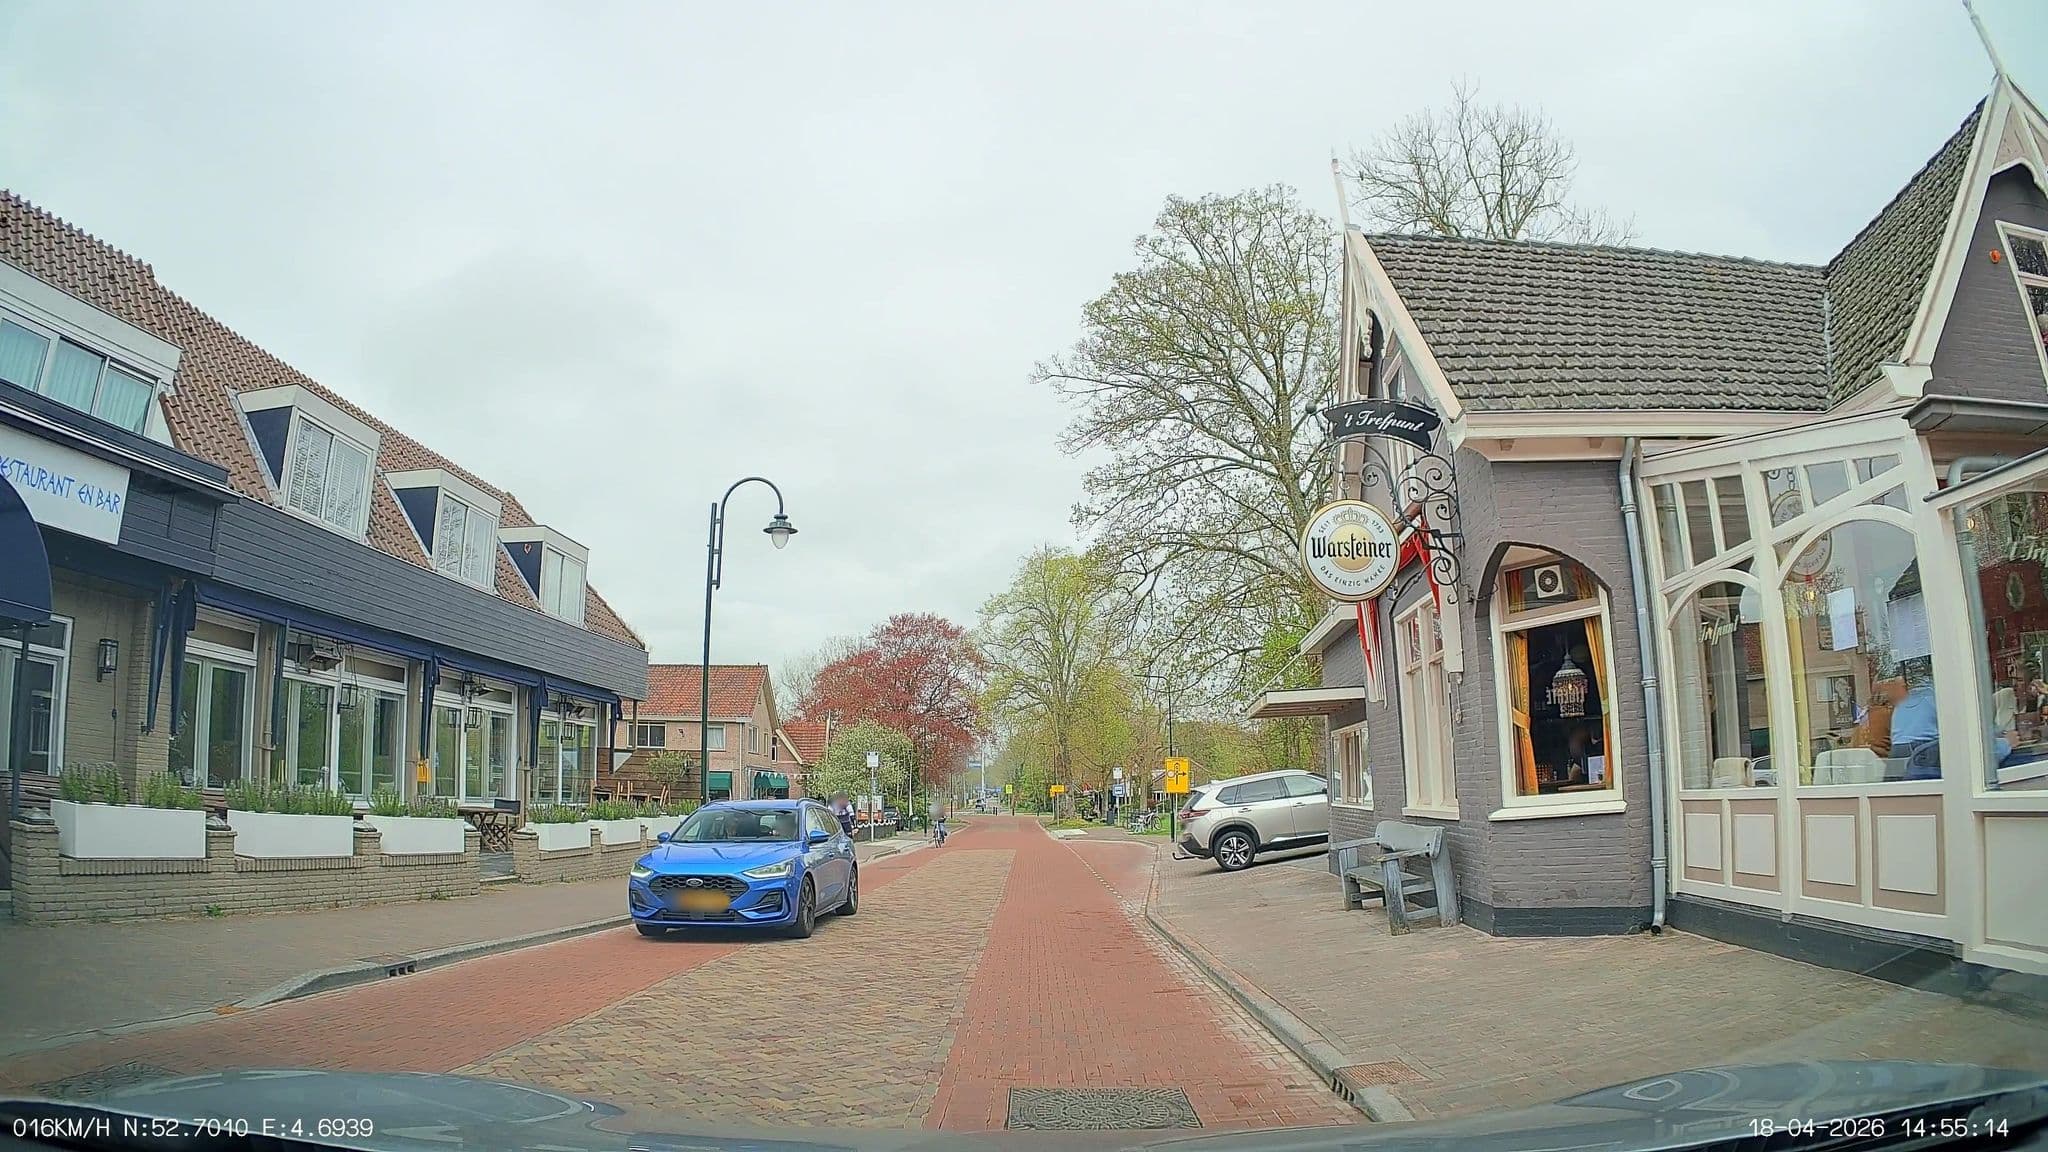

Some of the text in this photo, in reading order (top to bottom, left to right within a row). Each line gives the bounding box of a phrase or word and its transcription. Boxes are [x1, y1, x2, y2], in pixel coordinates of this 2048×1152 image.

[1344, 410, 1425, 432] 't Trefpunt
[0, 455, 121, 514] ESTAURANT EN BAR
[1311, 532, 1392, 560] Warsteiner
[1320, 565, 1333, 579] DAS
[1334, 576, 1361, 587] EINZIG
